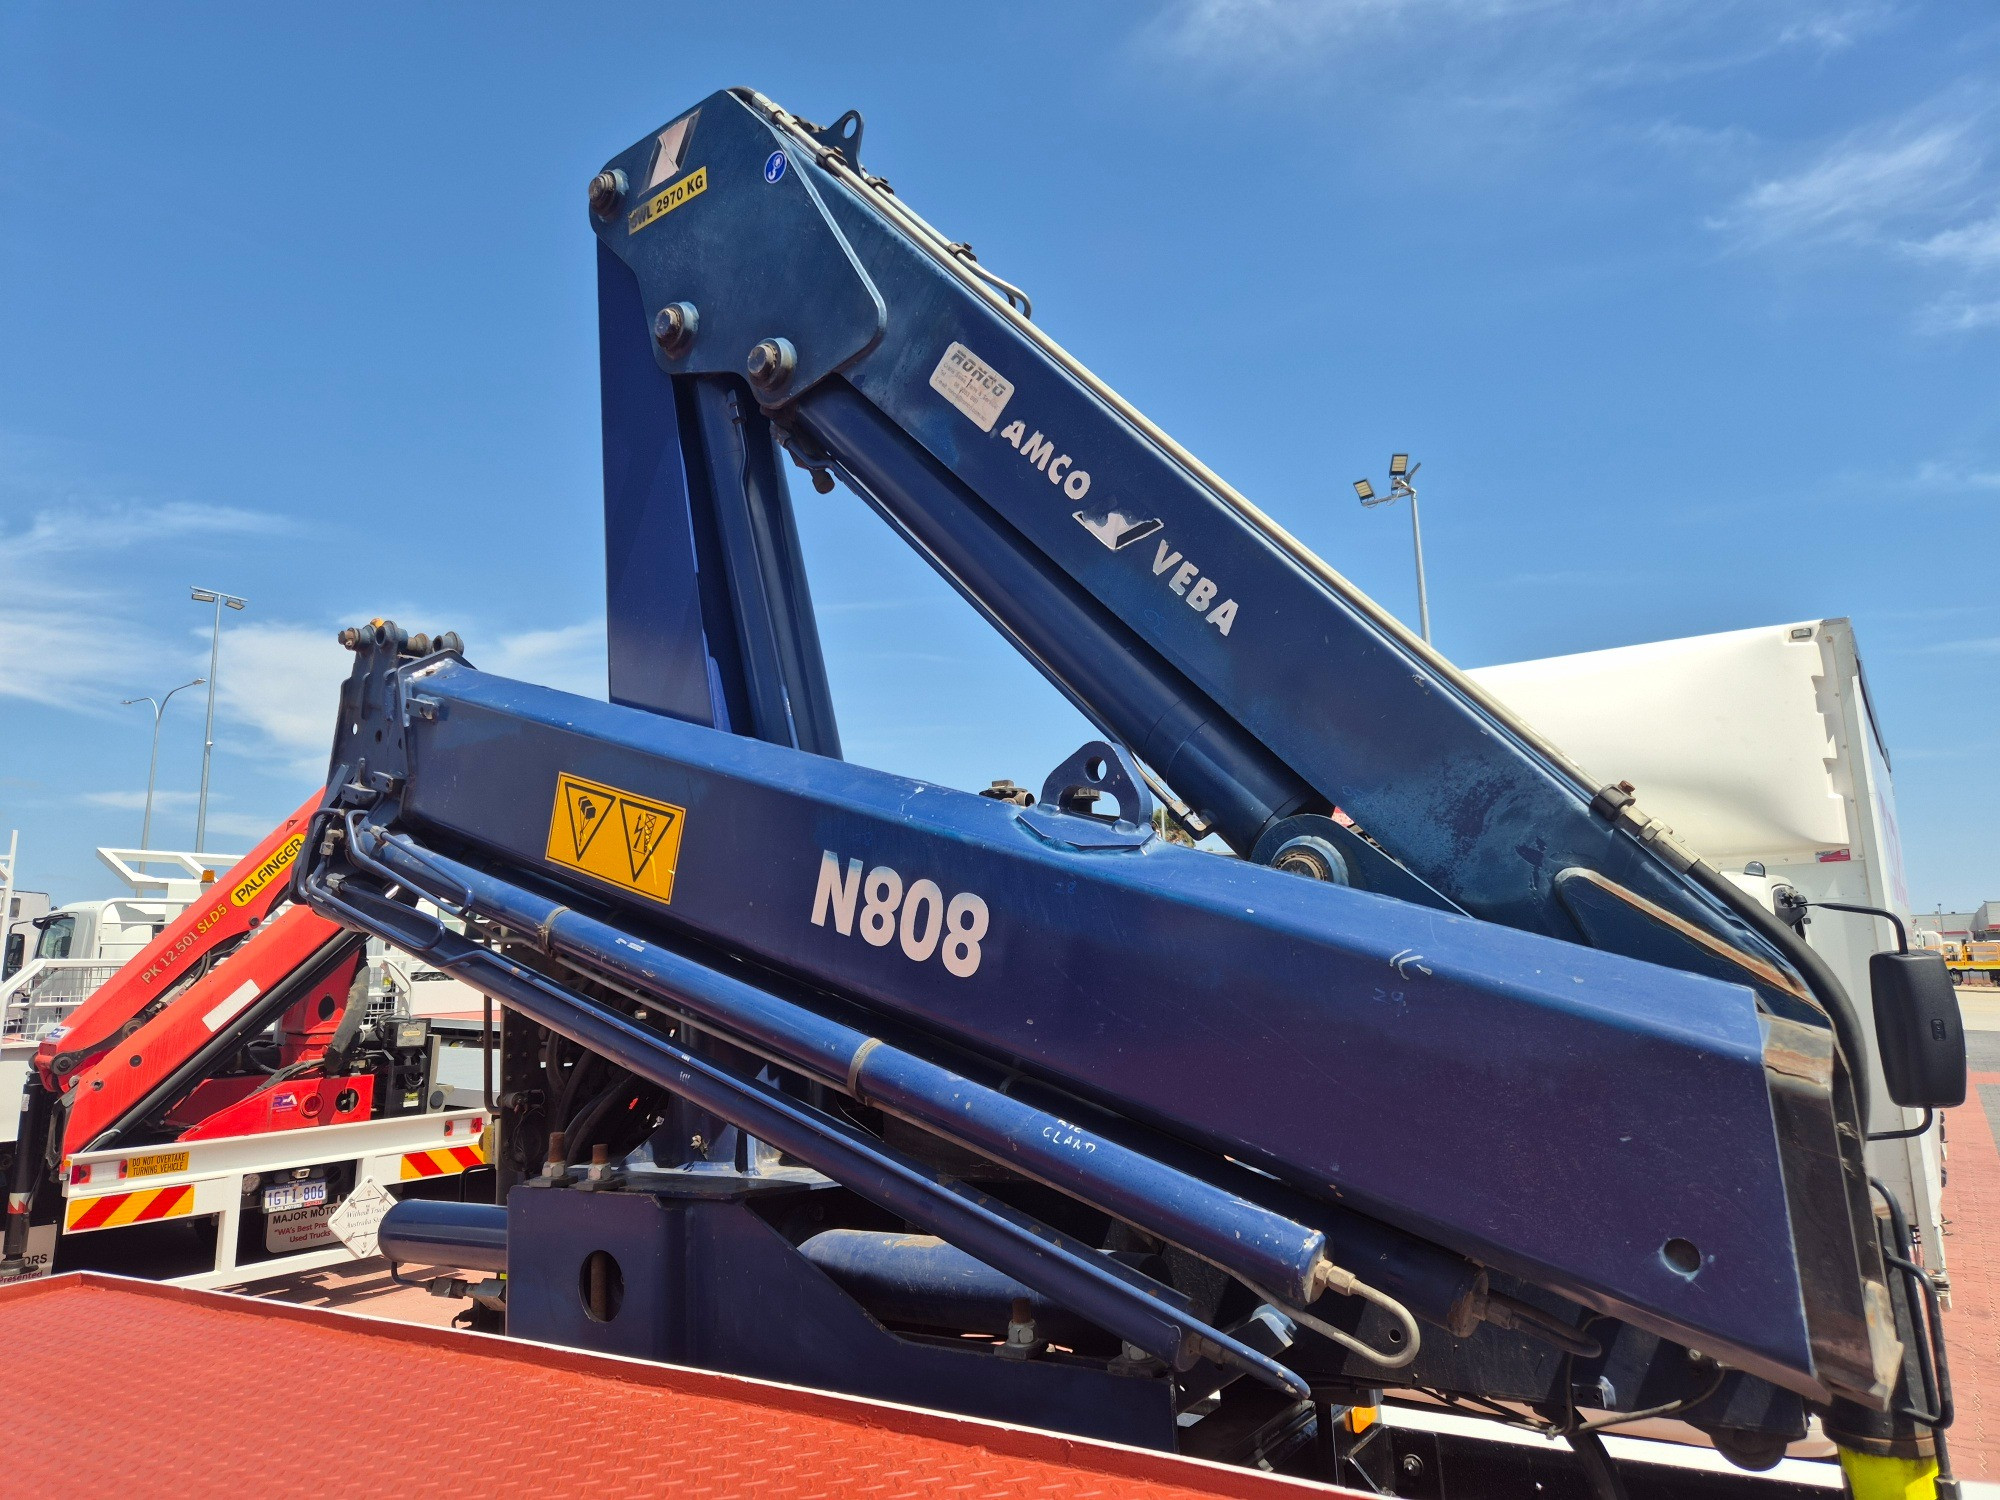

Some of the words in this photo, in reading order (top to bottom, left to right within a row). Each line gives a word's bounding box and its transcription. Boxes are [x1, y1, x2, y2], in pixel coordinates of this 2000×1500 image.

[656, 187, 683, 214] 2970
[687, 174, 704, 195] KG
[1001, 420, 1091, 500] AMCO
[1152, 539, 1229, 637] VEBA
[235, 838, 302, 903] PALFINGER
[811, 849, 990, 978] N808
[141, 964, 162, 984] PK
[160, 931, 199, 967] 12.501
[197, 903, 227, 934] SLD5
[132, 1158, 141, 1167] DO
[143, 1156, 154, 1166] NOT
[157, 1152, 186, 1164] OVERTAKE
[133, 1164, 158, 1176] TURNING
[160, 1161, 184, 1173] VEHICLE
[272, 1211, 307, 1224] MAJOR
[310, 1205, 340, 1218] MOTO
[297, 1224, 313, 1232] Best
[290, 1233, 308, 1242] Used
